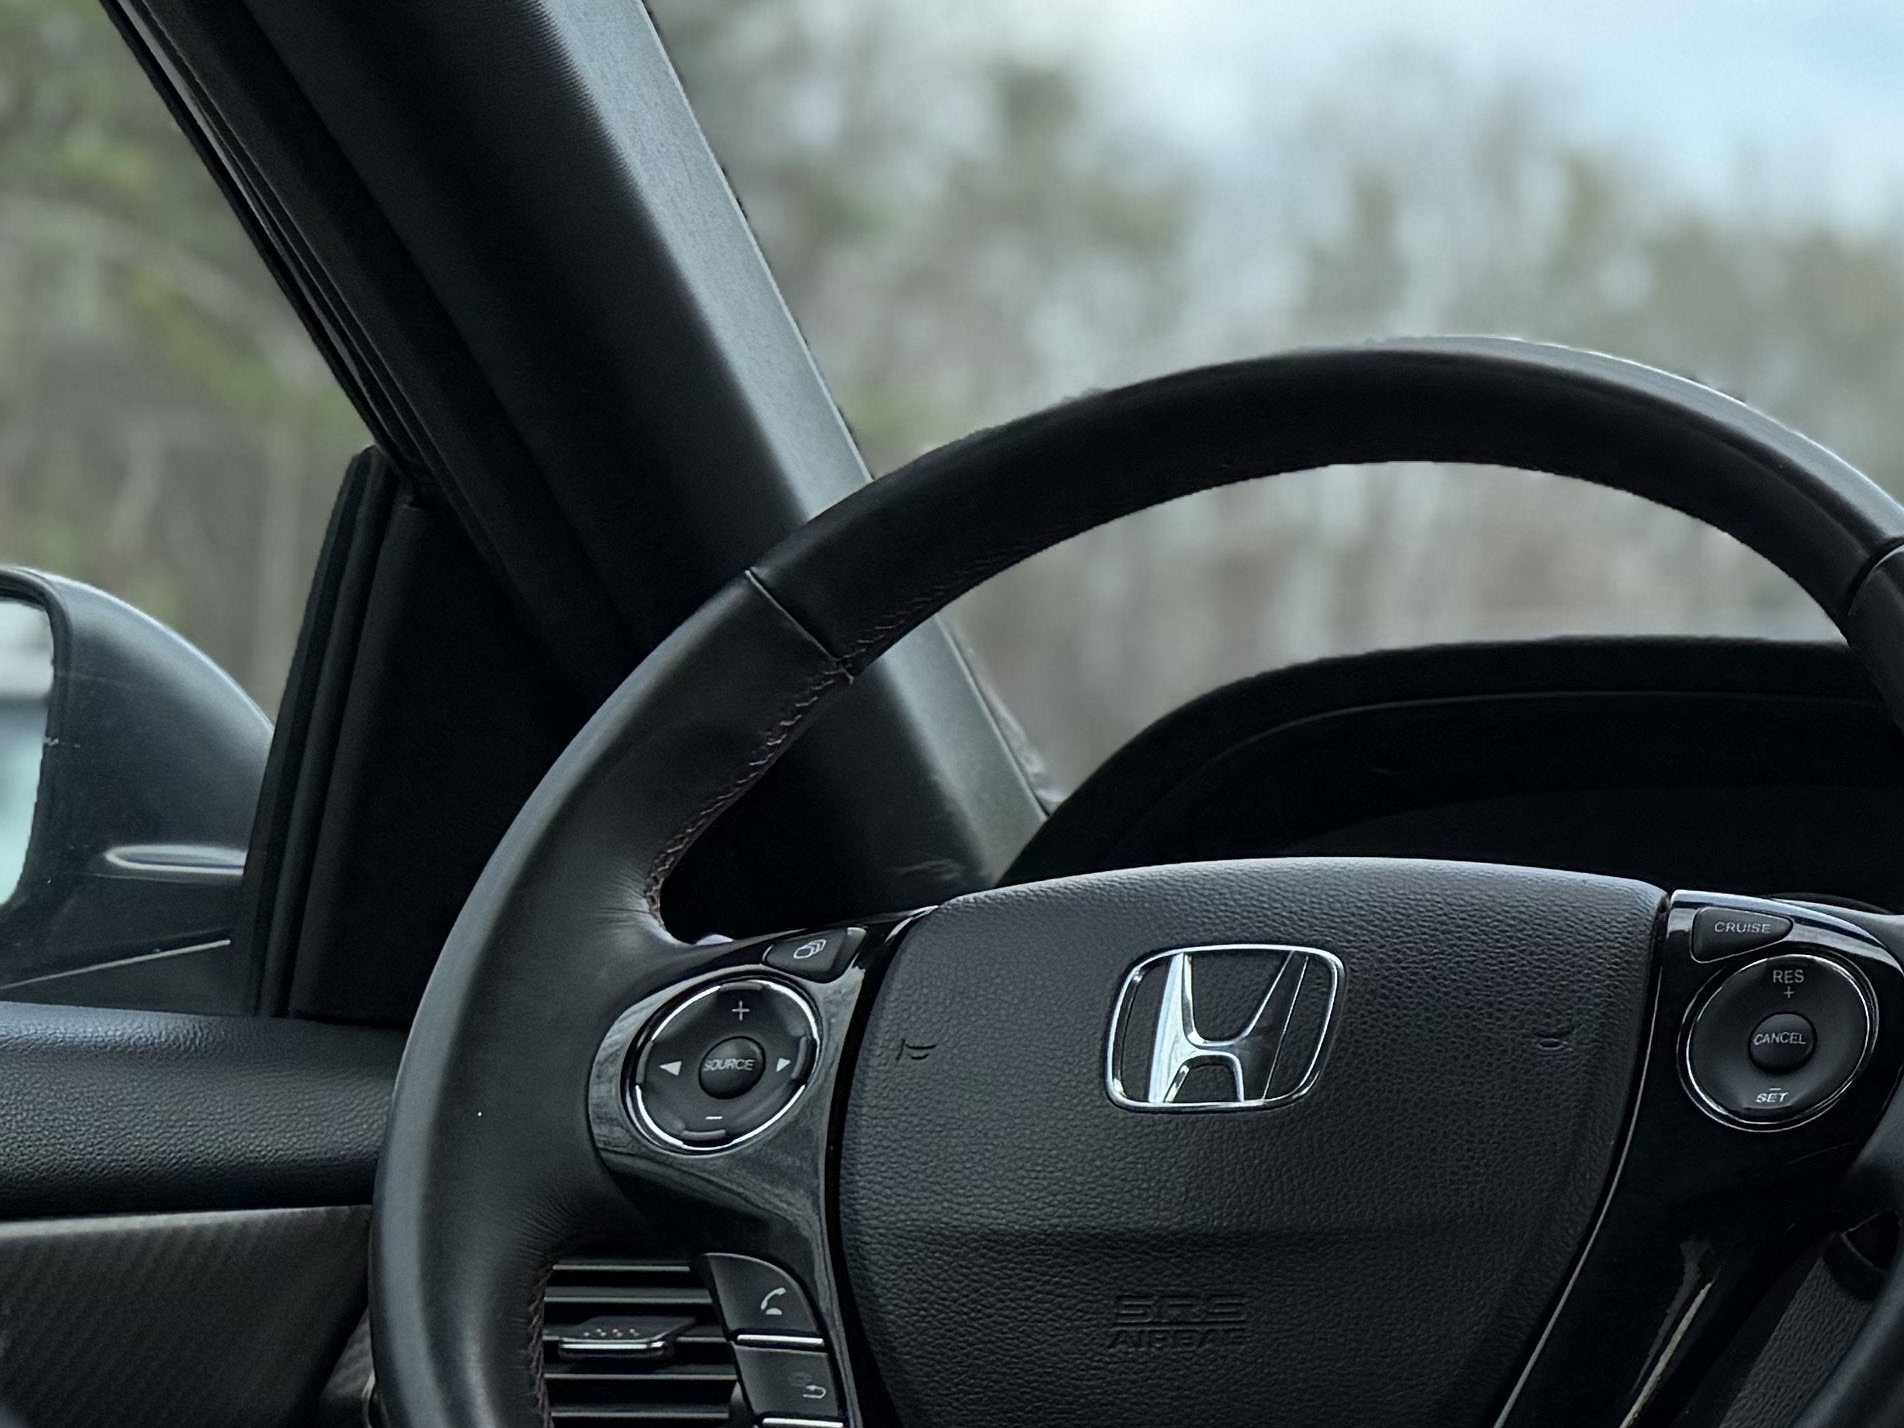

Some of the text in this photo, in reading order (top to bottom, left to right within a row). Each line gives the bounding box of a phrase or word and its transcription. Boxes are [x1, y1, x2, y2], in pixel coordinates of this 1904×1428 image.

[1714, 920, 1772, 933] CRUISE
[1772, 969, 1805, 984] RES
[1753, 1031, 1807, 1046] CANCEL
[703, 1057, 756, 1072] SOURCE
